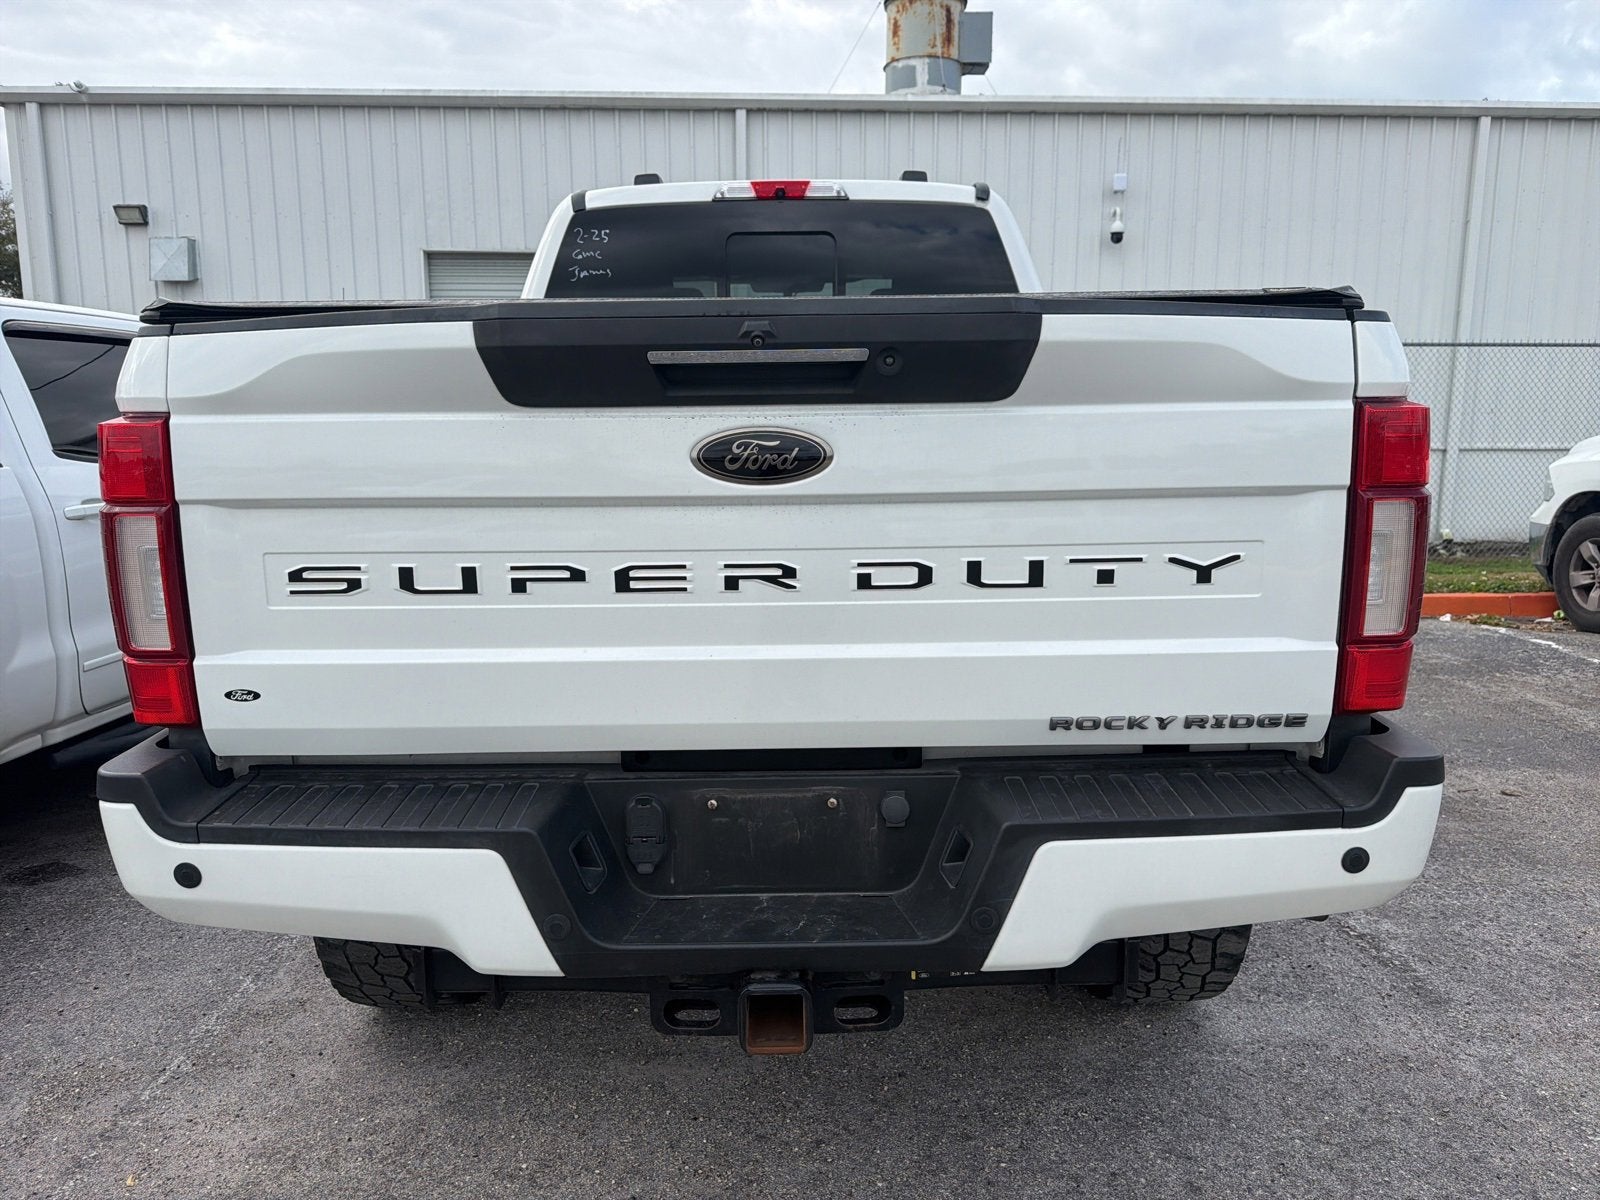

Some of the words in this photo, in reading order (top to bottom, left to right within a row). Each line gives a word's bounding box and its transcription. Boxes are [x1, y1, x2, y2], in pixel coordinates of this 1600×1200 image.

[574, 227, 610, 244] 2-25
[724, 439, 800, 471] Ford
[286, 562, 799, 595] SUPER
[852, 553, 1246, 591] DUTY
[230, 690, 255, 701] Ford
[1049, 715, 1178, 731] ROCKY
[1183, 713, 1309, 730] RIDGE
